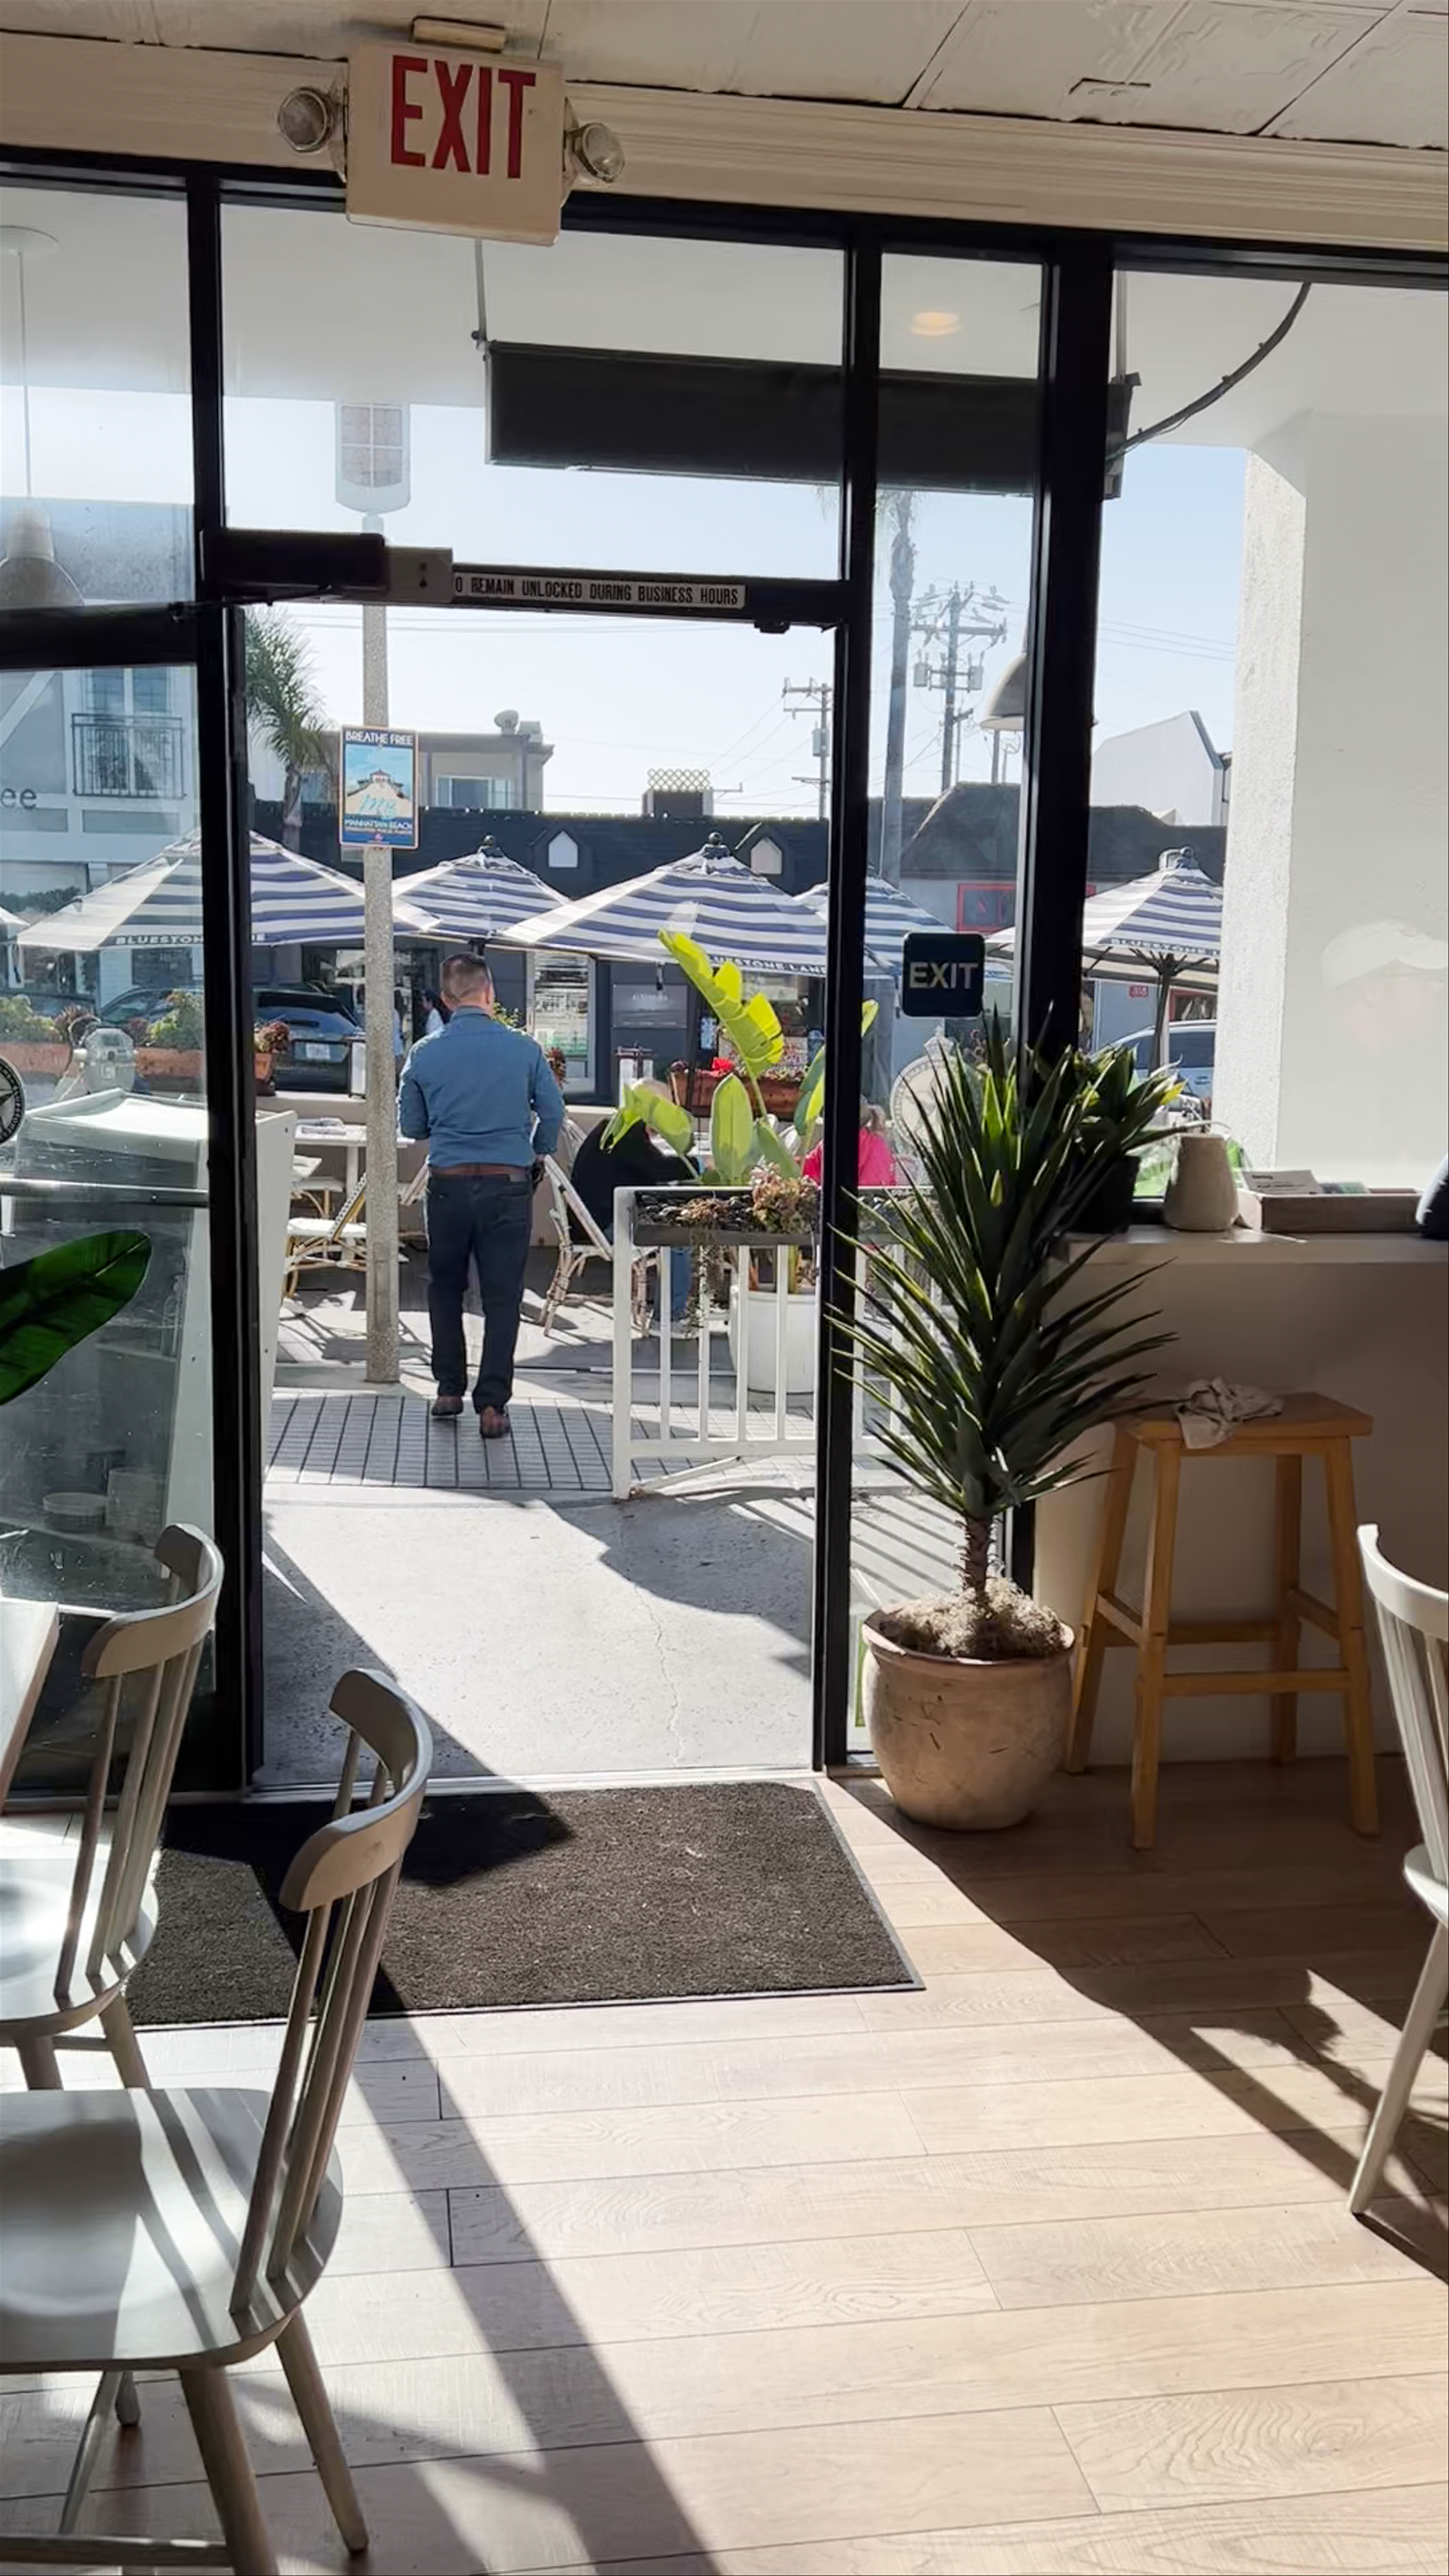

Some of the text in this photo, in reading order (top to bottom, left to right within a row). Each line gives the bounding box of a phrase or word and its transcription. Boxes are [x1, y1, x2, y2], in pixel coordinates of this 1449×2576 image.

[391, 55, 536, 178] EXIT
[455, 577, 738, 605] O REMAIN UNLOCKED DURING BUSINESS HOURS
[345, 730, 413, 746] BREATHE FREE
[115, 935, 204, 945] BLUESTON
[909, 962, 979, 989] EXIT
